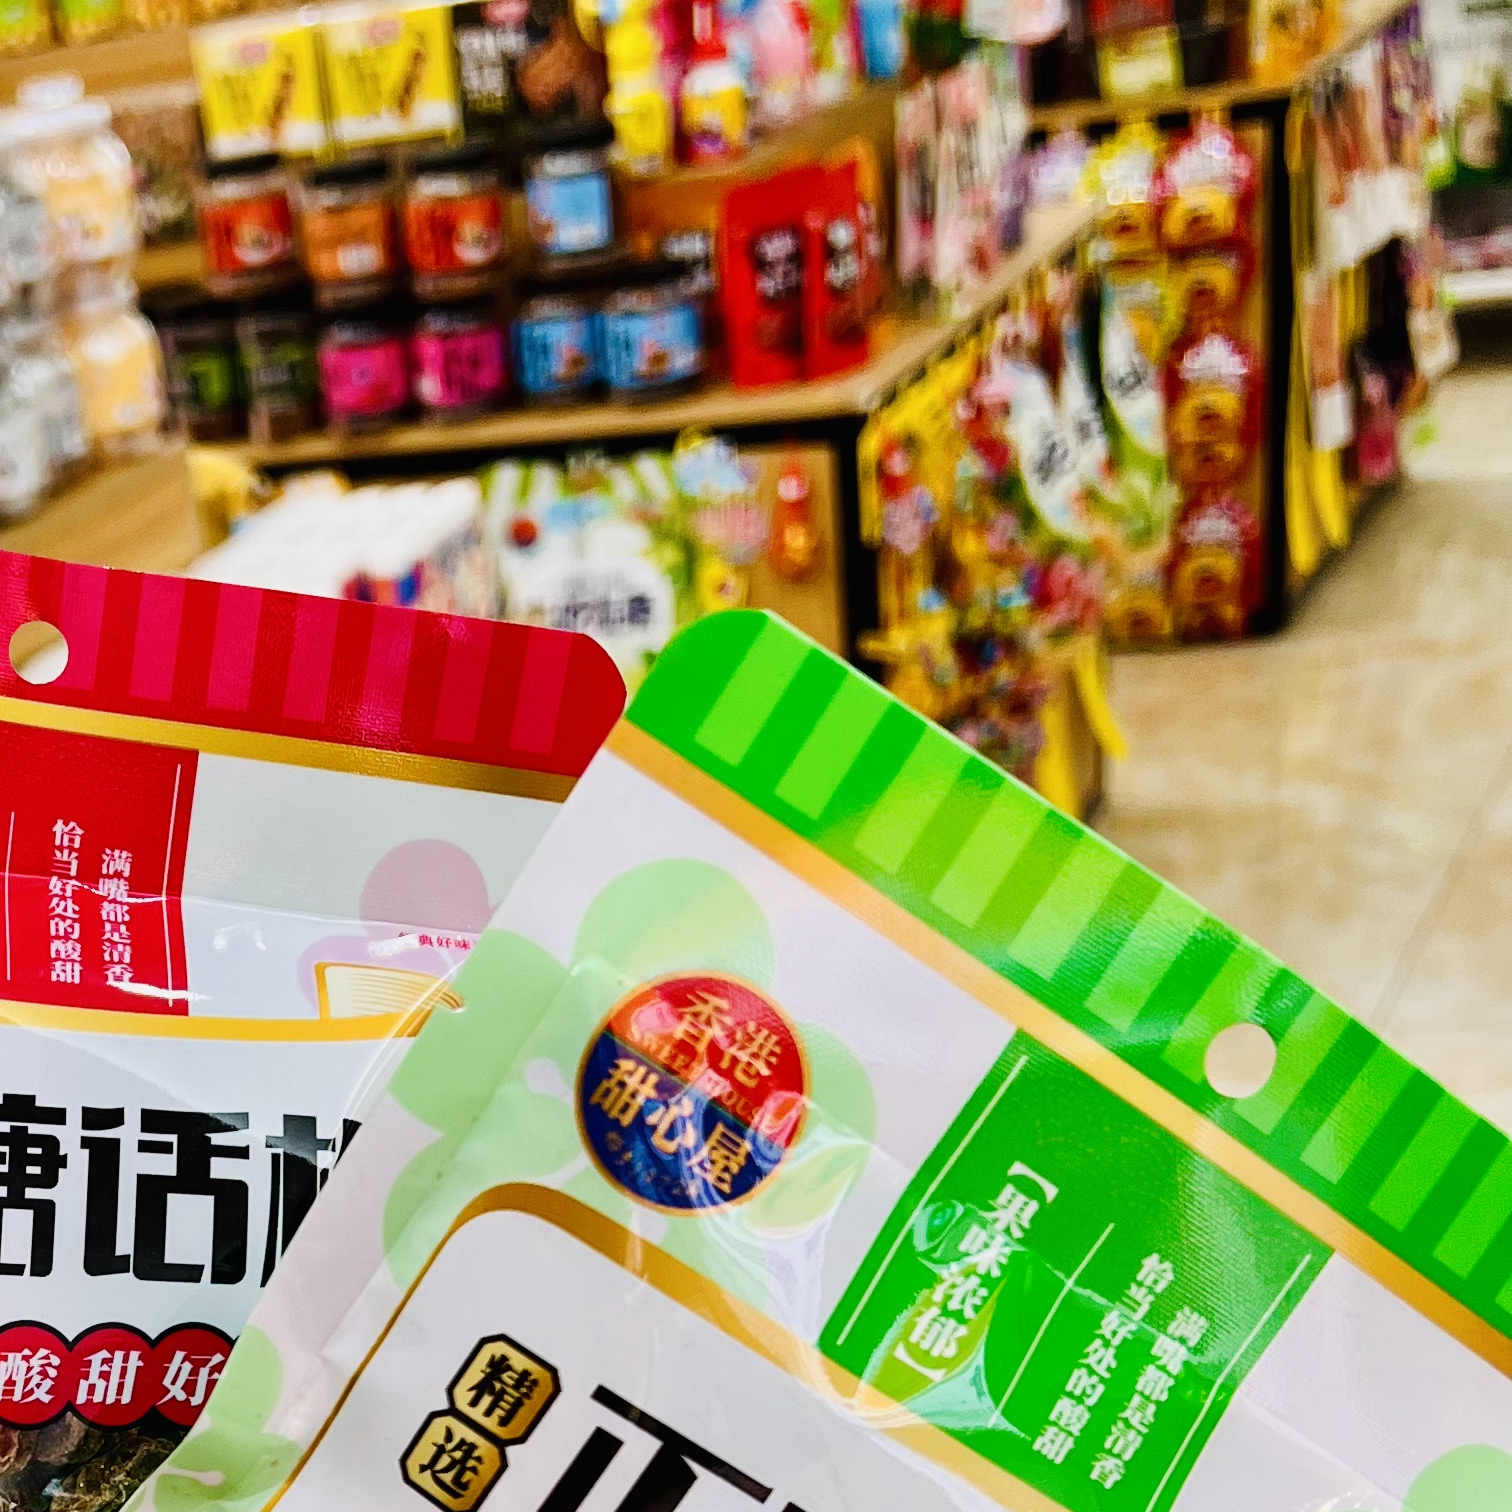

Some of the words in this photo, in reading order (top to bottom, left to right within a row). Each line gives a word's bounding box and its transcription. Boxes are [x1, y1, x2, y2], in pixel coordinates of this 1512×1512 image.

[48, 818, 85, 985] 恰当好处的酸甜
[97, 848, 135, 985] 满嘴都是清香
[672, 990, 781, 1088] 香港
[589, 1057, 754, 1195] 甜心屋
[420, 1351, 543, 1502] 精选
[1032, 1252, 1175, 1465] 恰当好处的酸甜
[1089, 1306, 1210, 1491] 满嘴都是清香
